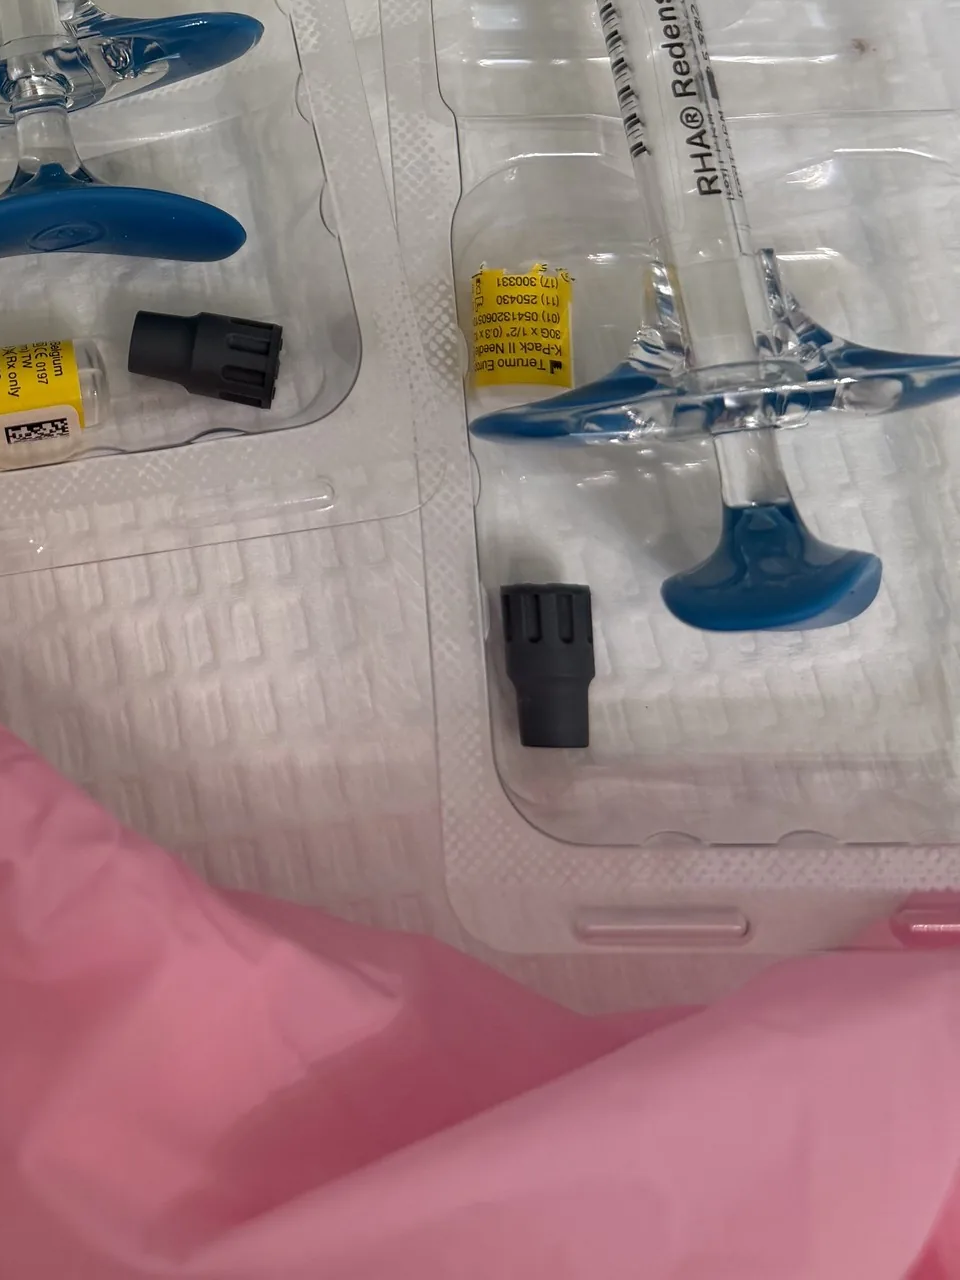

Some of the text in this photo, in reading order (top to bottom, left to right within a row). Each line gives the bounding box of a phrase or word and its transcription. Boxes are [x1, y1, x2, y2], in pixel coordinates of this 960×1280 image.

[680, 106, 722, 197] RHA®
[496, 275, 558, 289] (17) 300331
[496, 293, 560, 307] (11) 250430
[542, 311, 560, 324] (01)
[531, 327, 538, 336] x
[540, 328, 560, 340] 30G
[519, 341, 562, 356] K-Pack
[21, 354, 33, 369] TW
[498, 357, 546, 371] Terumo
[7, 356, 21, 398] Rx only
[36, 361, 49, 385] 0197
